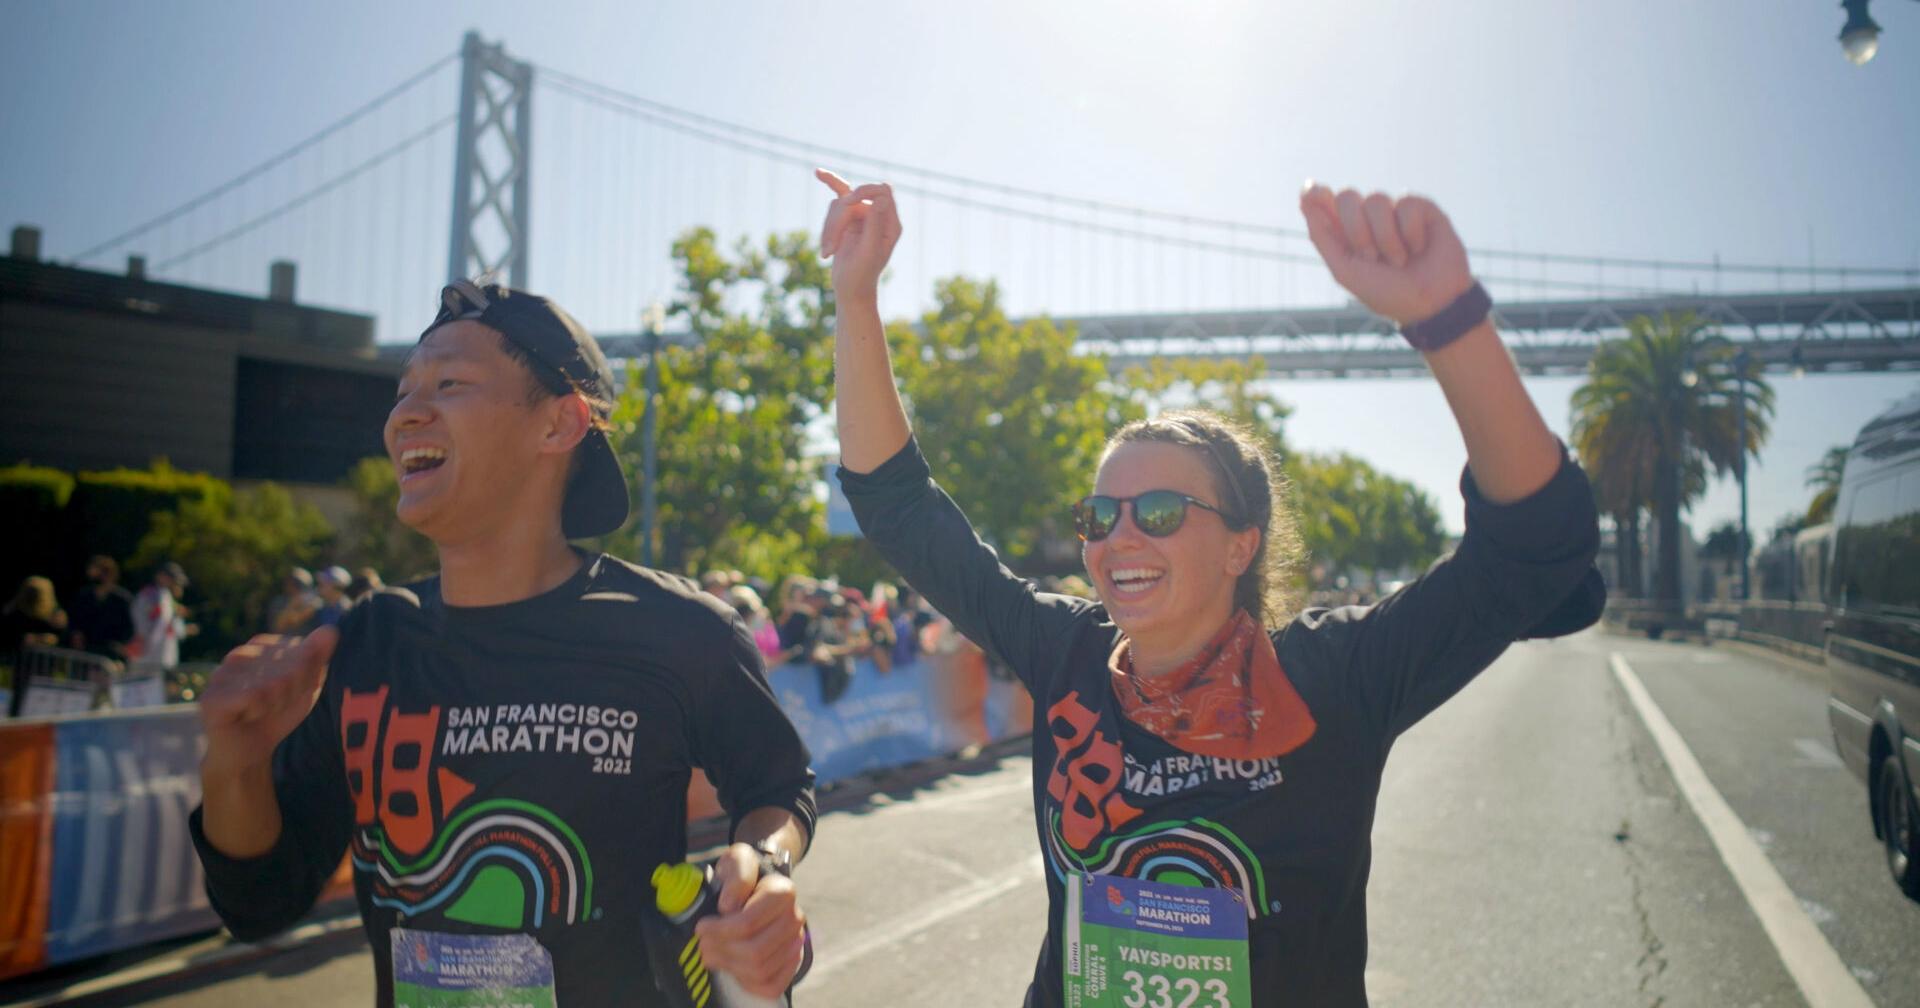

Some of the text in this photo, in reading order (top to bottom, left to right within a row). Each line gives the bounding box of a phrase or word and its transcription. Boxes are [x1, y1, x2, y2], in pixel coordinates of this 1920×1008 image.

[448, 704, 639, 730] SAN FRANCISCO
[442, 725, 635, 757] MARATHON
[592, 757, 632, 774] 2021
[1249, 770, 1284, 792] 2021
[1138, 906, 1211, 925] MARATHON
[1139, 898, 1156, 907] SAN
[1157, 900, 1210, 913] FRANCISCO
[1118, 945, 1233, 971] YAYSPORTS!
[1090, 955, 1099, 999] CORRAL
[1123, 970, 1232, 1008] 3323
